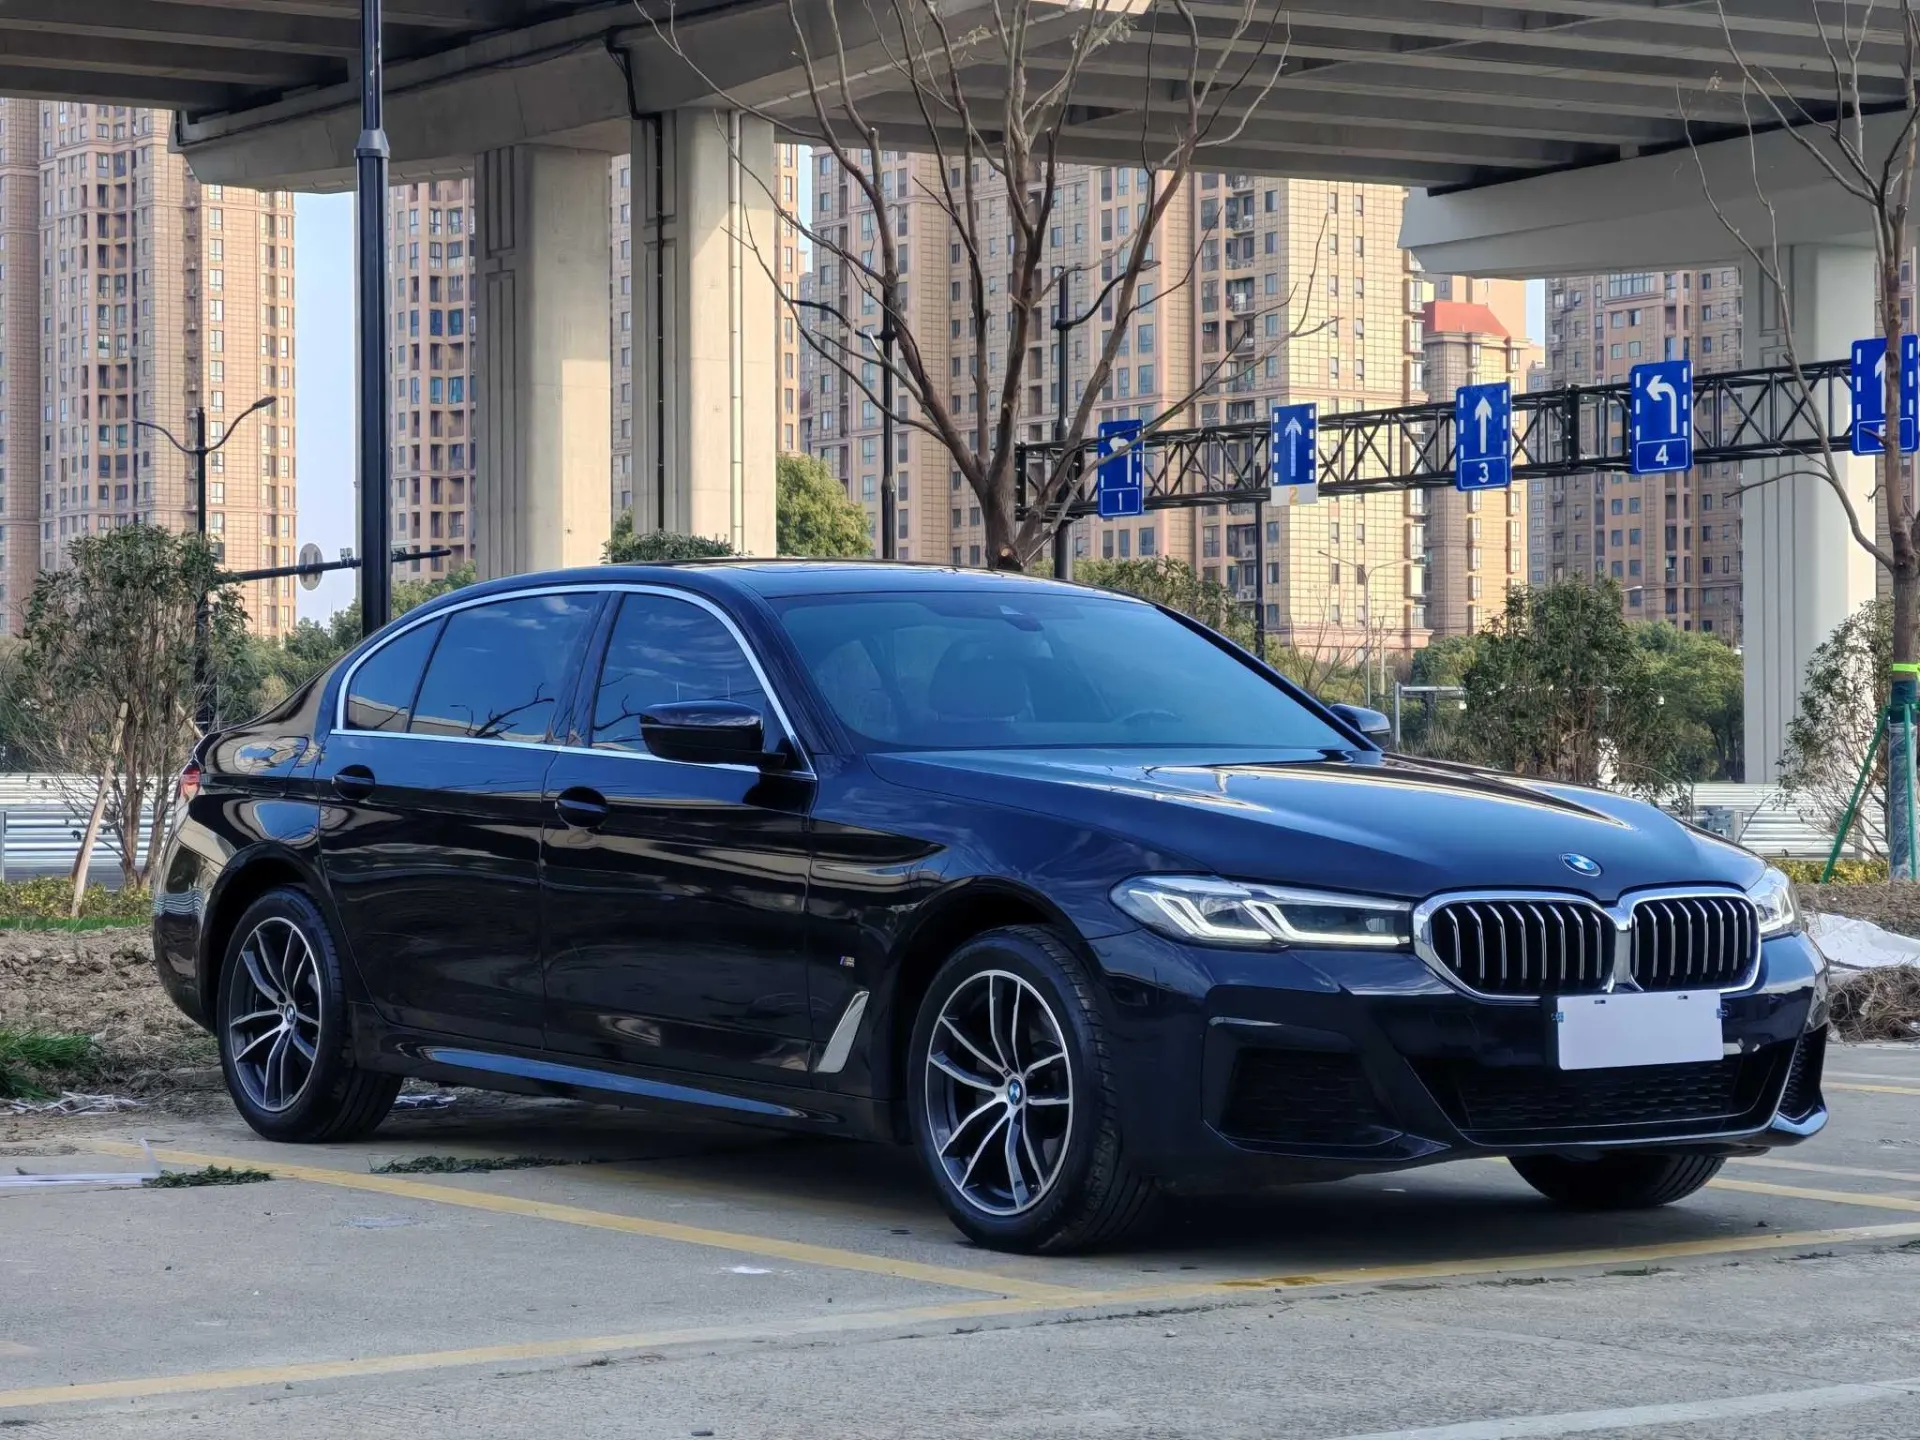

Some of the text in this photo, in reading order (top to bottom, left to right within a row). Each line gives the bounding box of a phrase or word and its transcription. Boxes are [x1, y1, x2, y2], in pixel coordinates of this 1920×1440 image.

[1655, 444, 1669, 466] 4
[1478, 462, 1489, 483] 3
[1118, 492, 1123, 511] 1
[1289, 486, 1299, 505] 2
